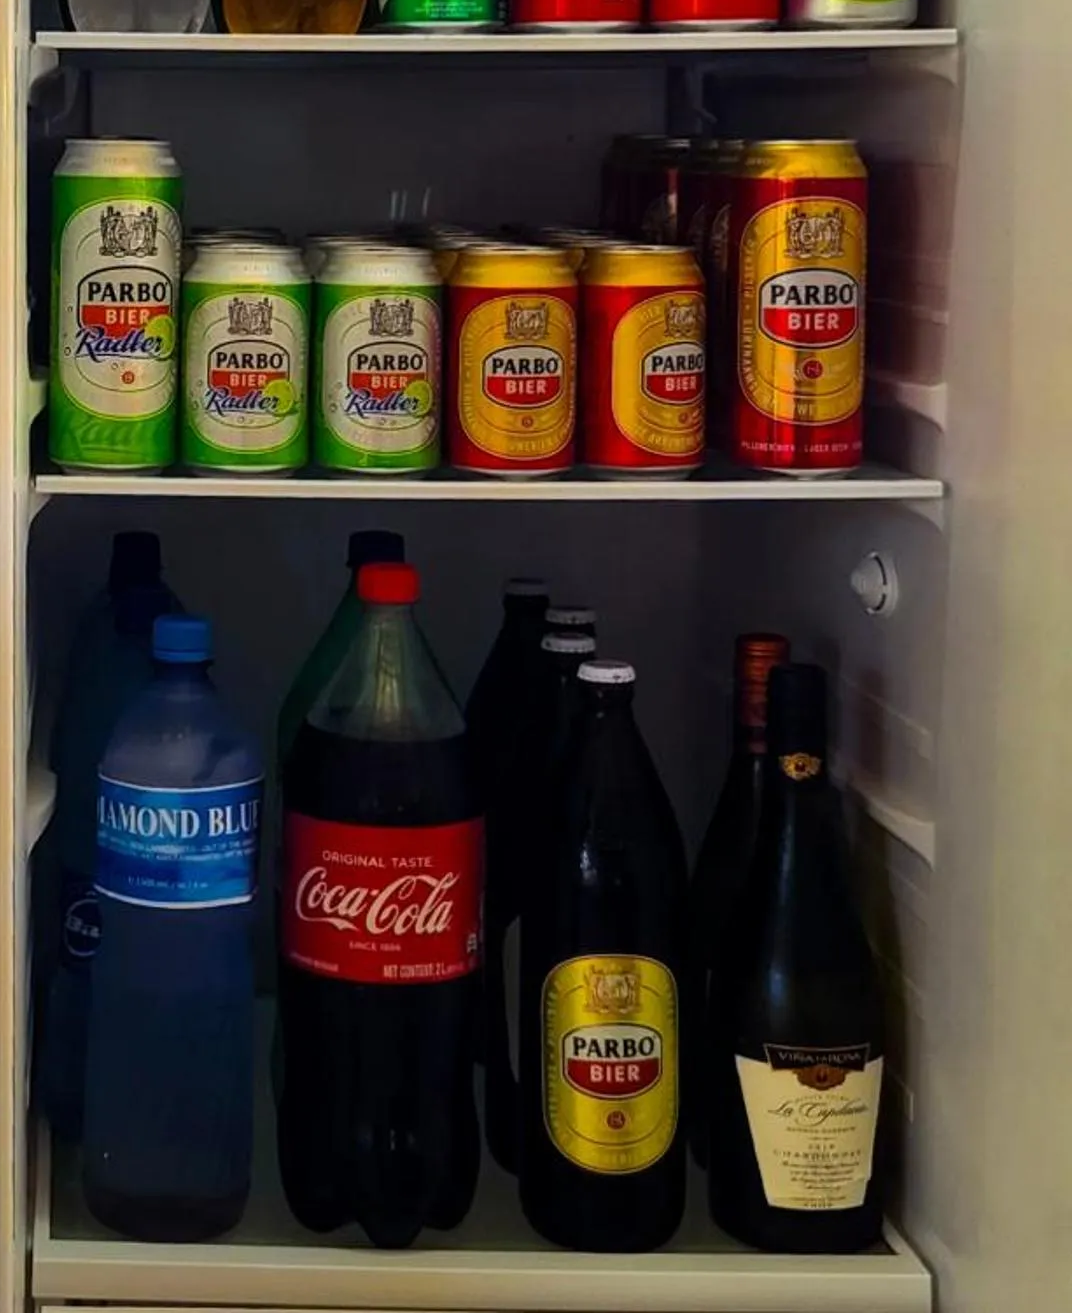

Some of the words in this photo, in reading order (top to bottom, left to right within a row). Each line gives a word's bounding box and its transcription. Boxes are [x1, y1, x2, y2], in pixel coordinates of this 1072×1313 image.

[88, 282, 167, 302] PARBO
[770, 284, 854, 306] PARBO
[105, 309, 149, 325] BIER
[788, 313, 839, 330] BIER
[75, 325, 164, 363] Radler
[216, 352, 284, 368] PARBO
[357, 354, 423, 370] PARBO
[492, 358, 558, 374] PARBO
[652, 354, 703, 372] PARBO
[230, 374, 267, 387] BIER
[371, 375, 408, 388] BIER
[505, 380, 546, 394] BIER
[665, 377, 697, 391] BIER
[204, 388, 279, 416] Radler
[344, 390, 419, 418] Radler
[97, 795, 200, 838] IAMOND
[322, 850, 385, 868] ORIGINAL
[392, 857, 432, 868] TASTE
[296, 866, 460, 936] Coca-Cola
[573, 1036, 655, 1058] PARBO
[590, 1064, 640, 1083] BIER
